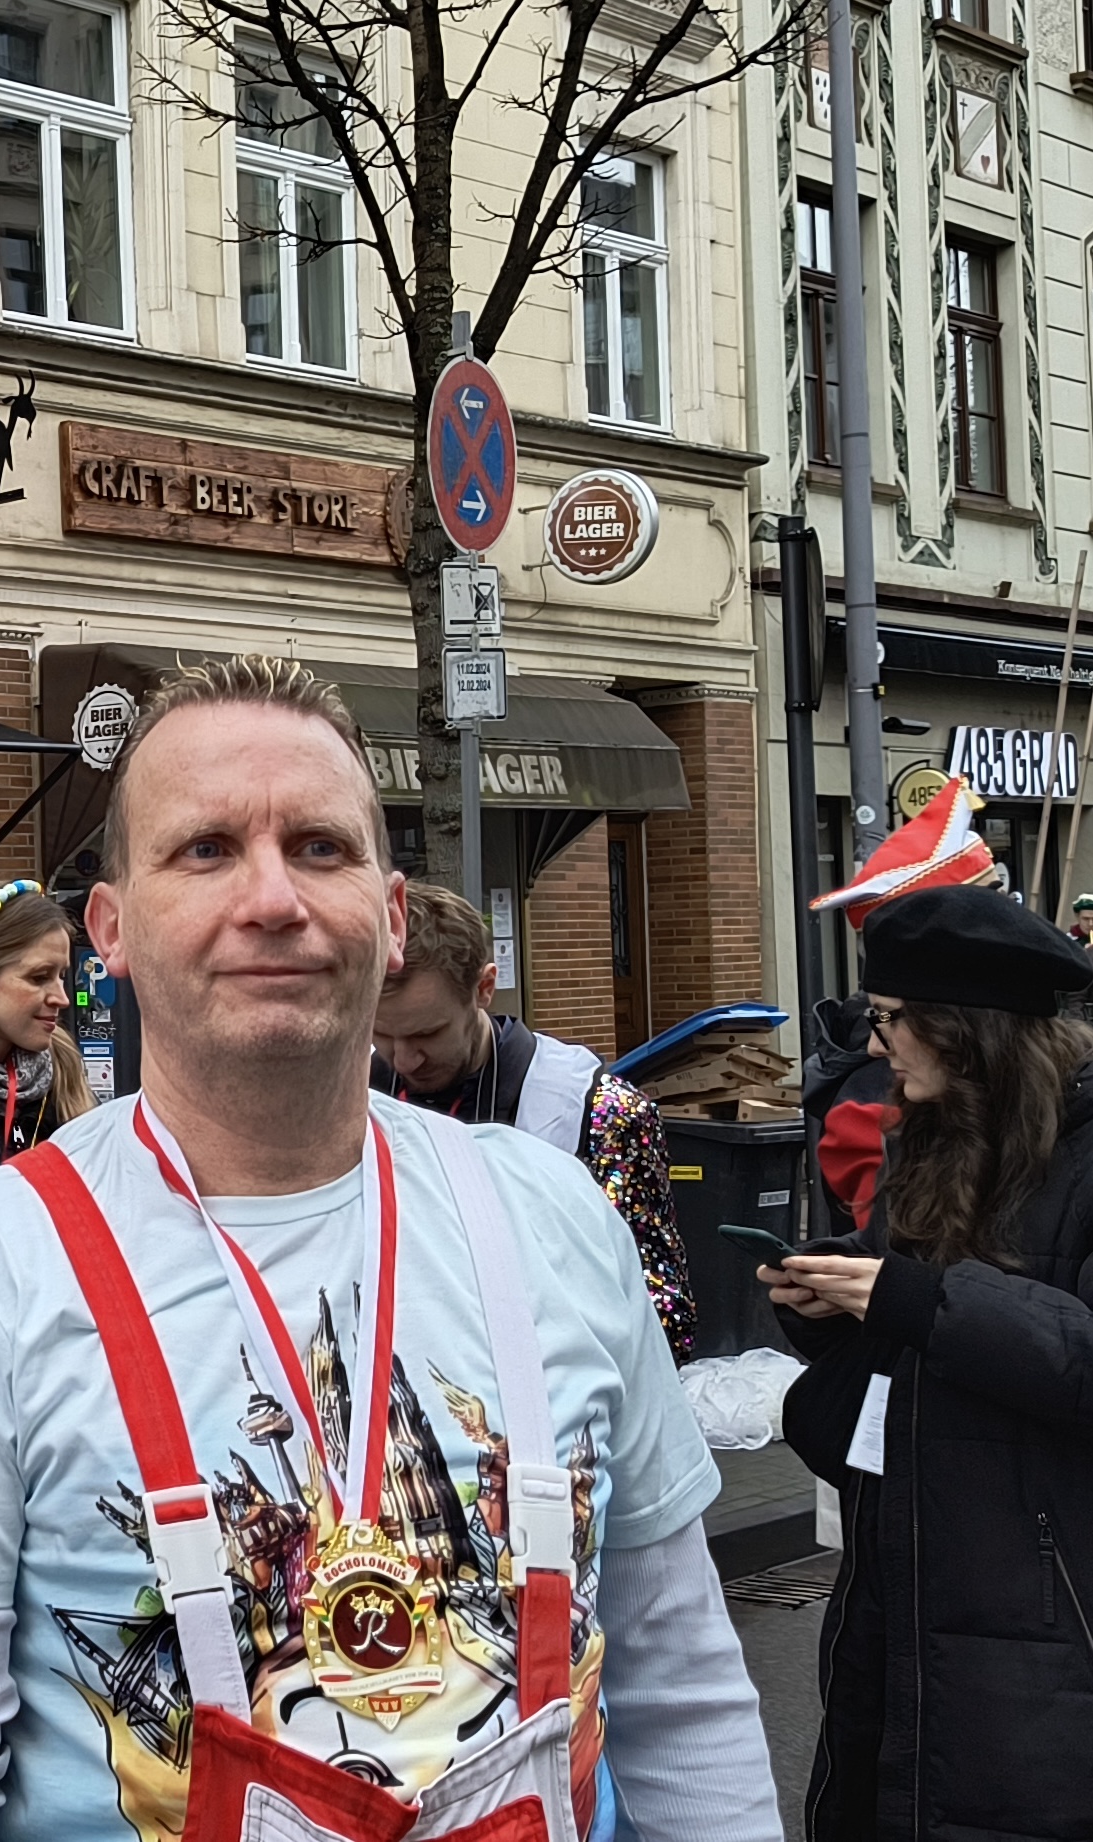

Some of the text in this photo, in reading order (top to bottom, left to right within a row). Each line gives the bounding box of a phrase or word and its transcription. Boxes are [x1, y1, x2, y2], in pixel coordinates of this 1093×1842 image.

[80, 459, 169, 504] CRAFT
[190, 474, 258, 517] BEER
[270, 486, 361, 529] STORE
[573, 505, 617, 521] BIER
[563, 522, 625, 538] LAGER
[457, 679, 491, 692] 12.02.2024
[90, 707, 123, 722] BIER
[84, 722, 129, 739] LAGER
[365, 746, 569, 795] BIE AGER
[341, 1520, 374, 1548] 75
